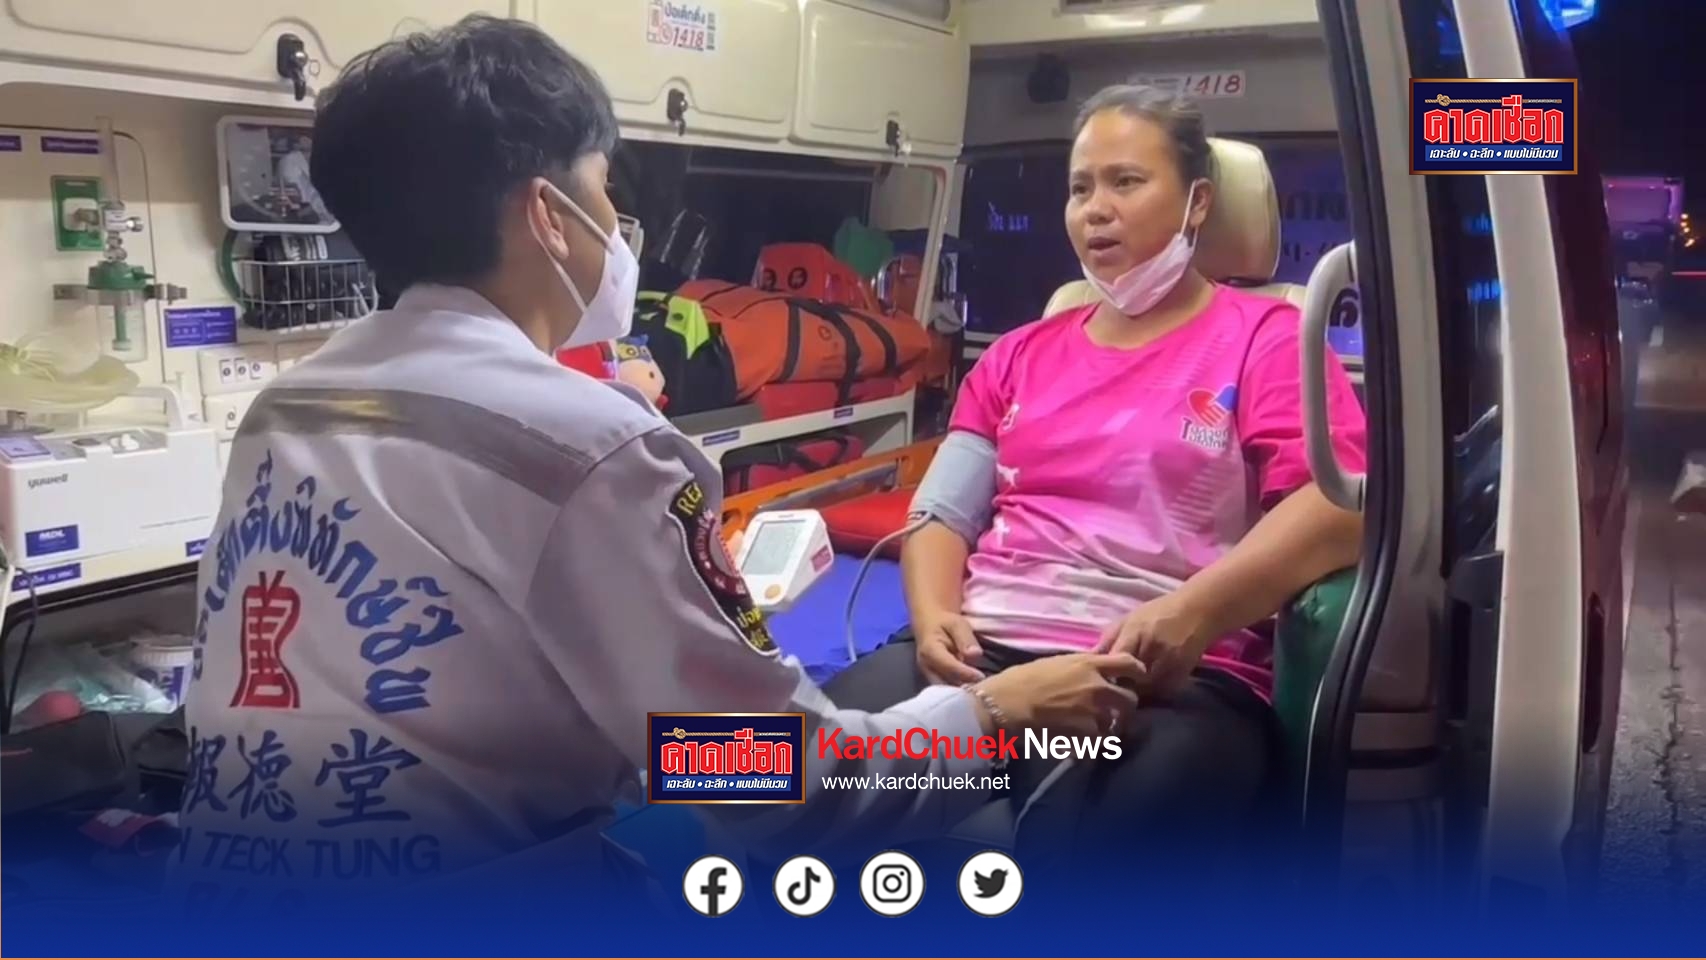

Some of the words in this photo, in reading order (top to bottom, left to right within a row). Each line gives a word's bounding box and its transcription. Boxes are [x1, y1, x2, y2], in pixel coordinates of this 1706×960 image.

[672, 26, 705, 48] 1418
[1184, 75, 1241, 94] 1418
[201, 831, 294, 877] TECK
[305, 833, 442, 880] TUNG
